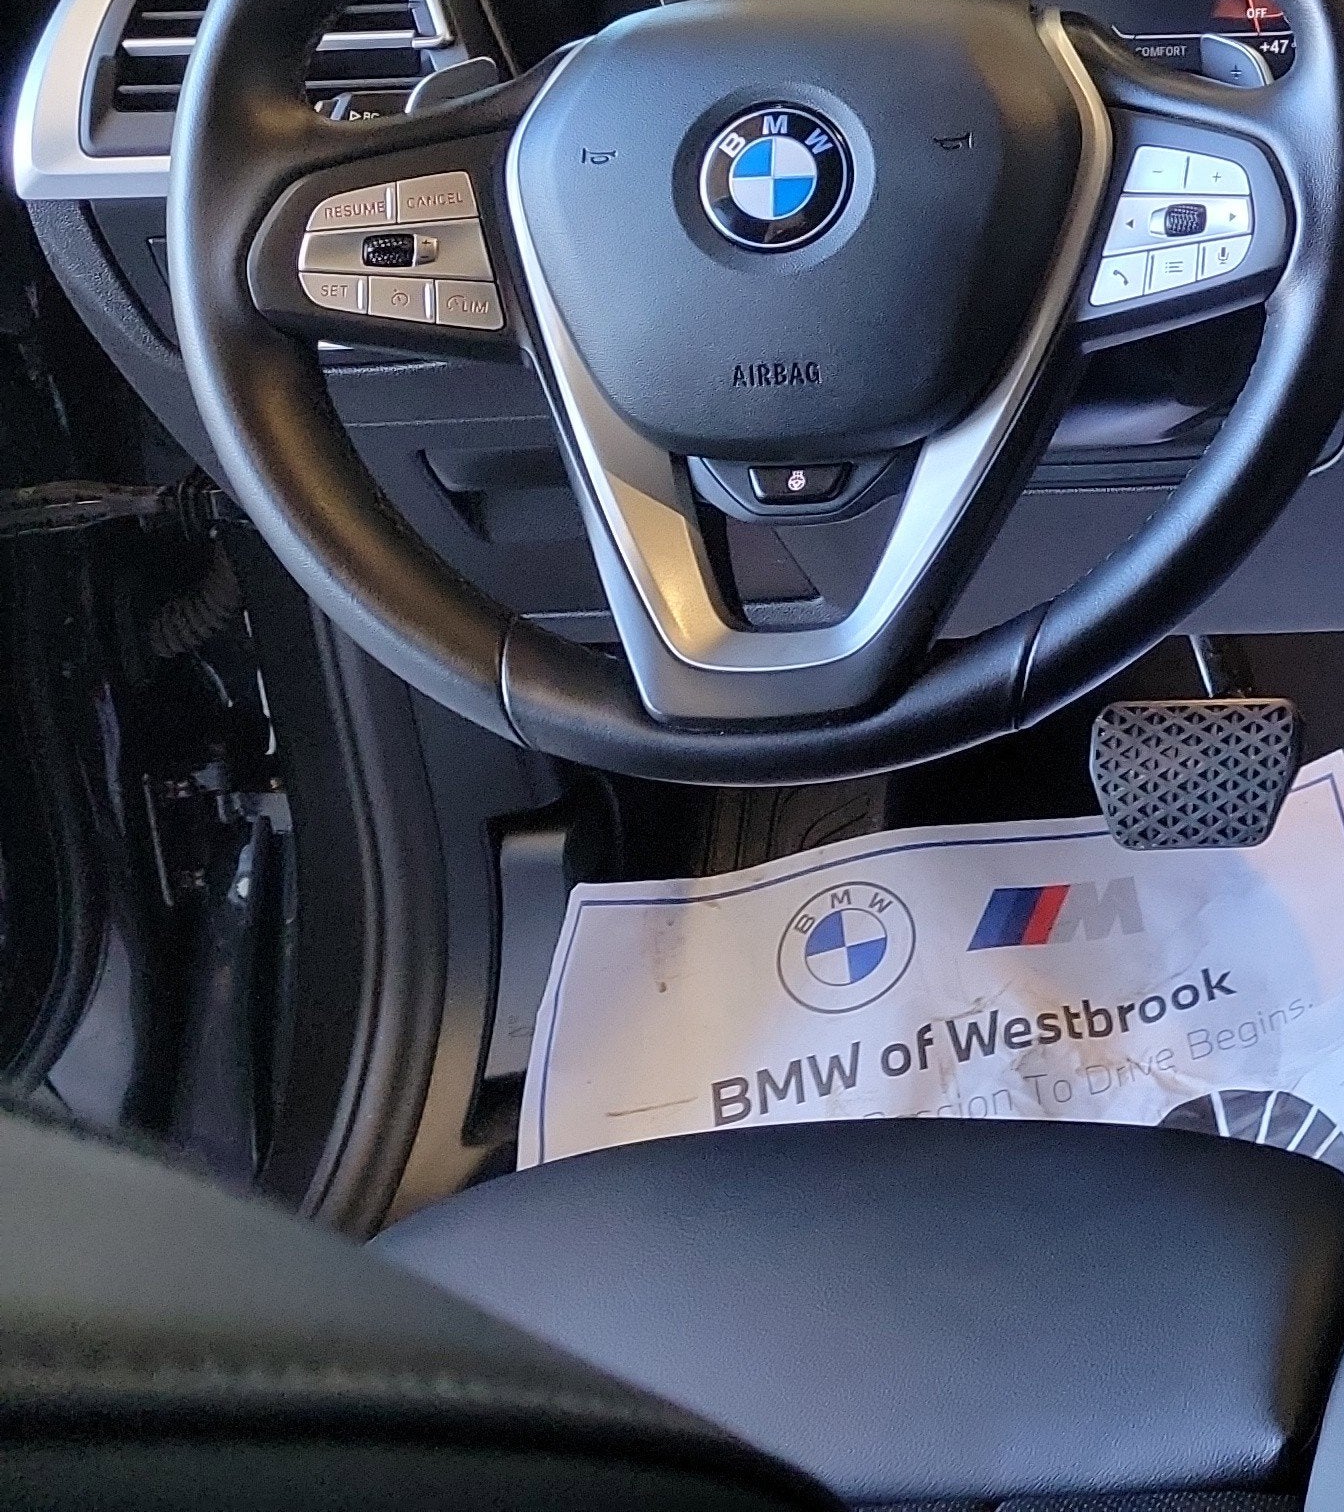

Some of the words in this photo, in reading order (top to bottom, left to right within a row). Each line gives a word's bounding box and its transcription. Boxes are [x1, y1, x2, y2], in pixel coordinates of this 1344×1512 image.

[1246, 7, 1267, 19] OFF
[719, 114, 834, 159] BMW
[324, 200, 386, 220] RESUME
[406, 192, 464, 209] CANCEL
[320, 284, 349, 298] SET
[461, 300, 489, 314] LIM
[732, 360, 823, 388] AIRBAG
[793, 888, 894, 935] BMW
[710, 1040, 861, 1128] BMW
[879, 1023, 935, 1078] of
[945, 967, 1239, 1063] Westbrook
[1022, 1072, 1072, 1105] To
[1085, 1045, 1177, 1098] Drive
[1185, 1001, 1314, 1063] Begins.
